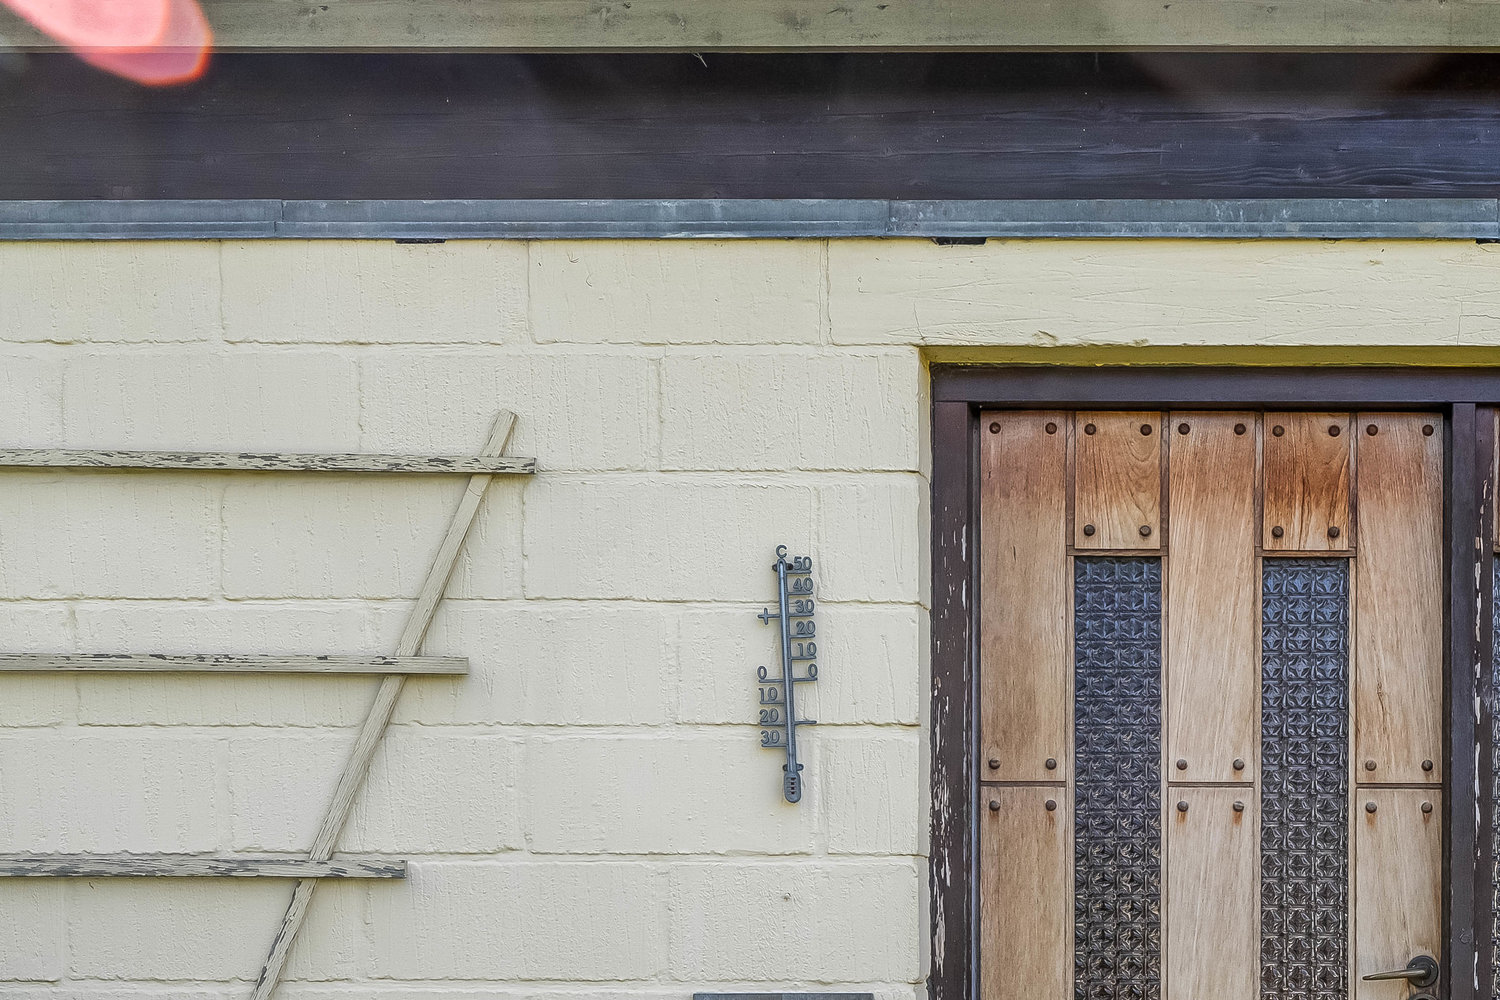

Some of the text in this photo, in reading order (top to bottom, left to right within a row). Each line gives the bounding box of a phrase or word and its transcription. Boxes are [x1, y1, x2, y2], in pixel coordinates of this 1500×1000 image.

[776, 545, 787, 558] C
[793, 556, 812, 570] 50
[793, 577, 814, 591] 40
[795, 599, 815, 613] 30
[796, 620, 816, 635] 20
[797, 642, 817, 656] 10
[757, 665, 768, 680] 0
[807, 664, 818, 678] 0
[758, 687, 778, 702] 10
[759, 708, 779, 723] 20
[760, 730, 780, 744] 30
